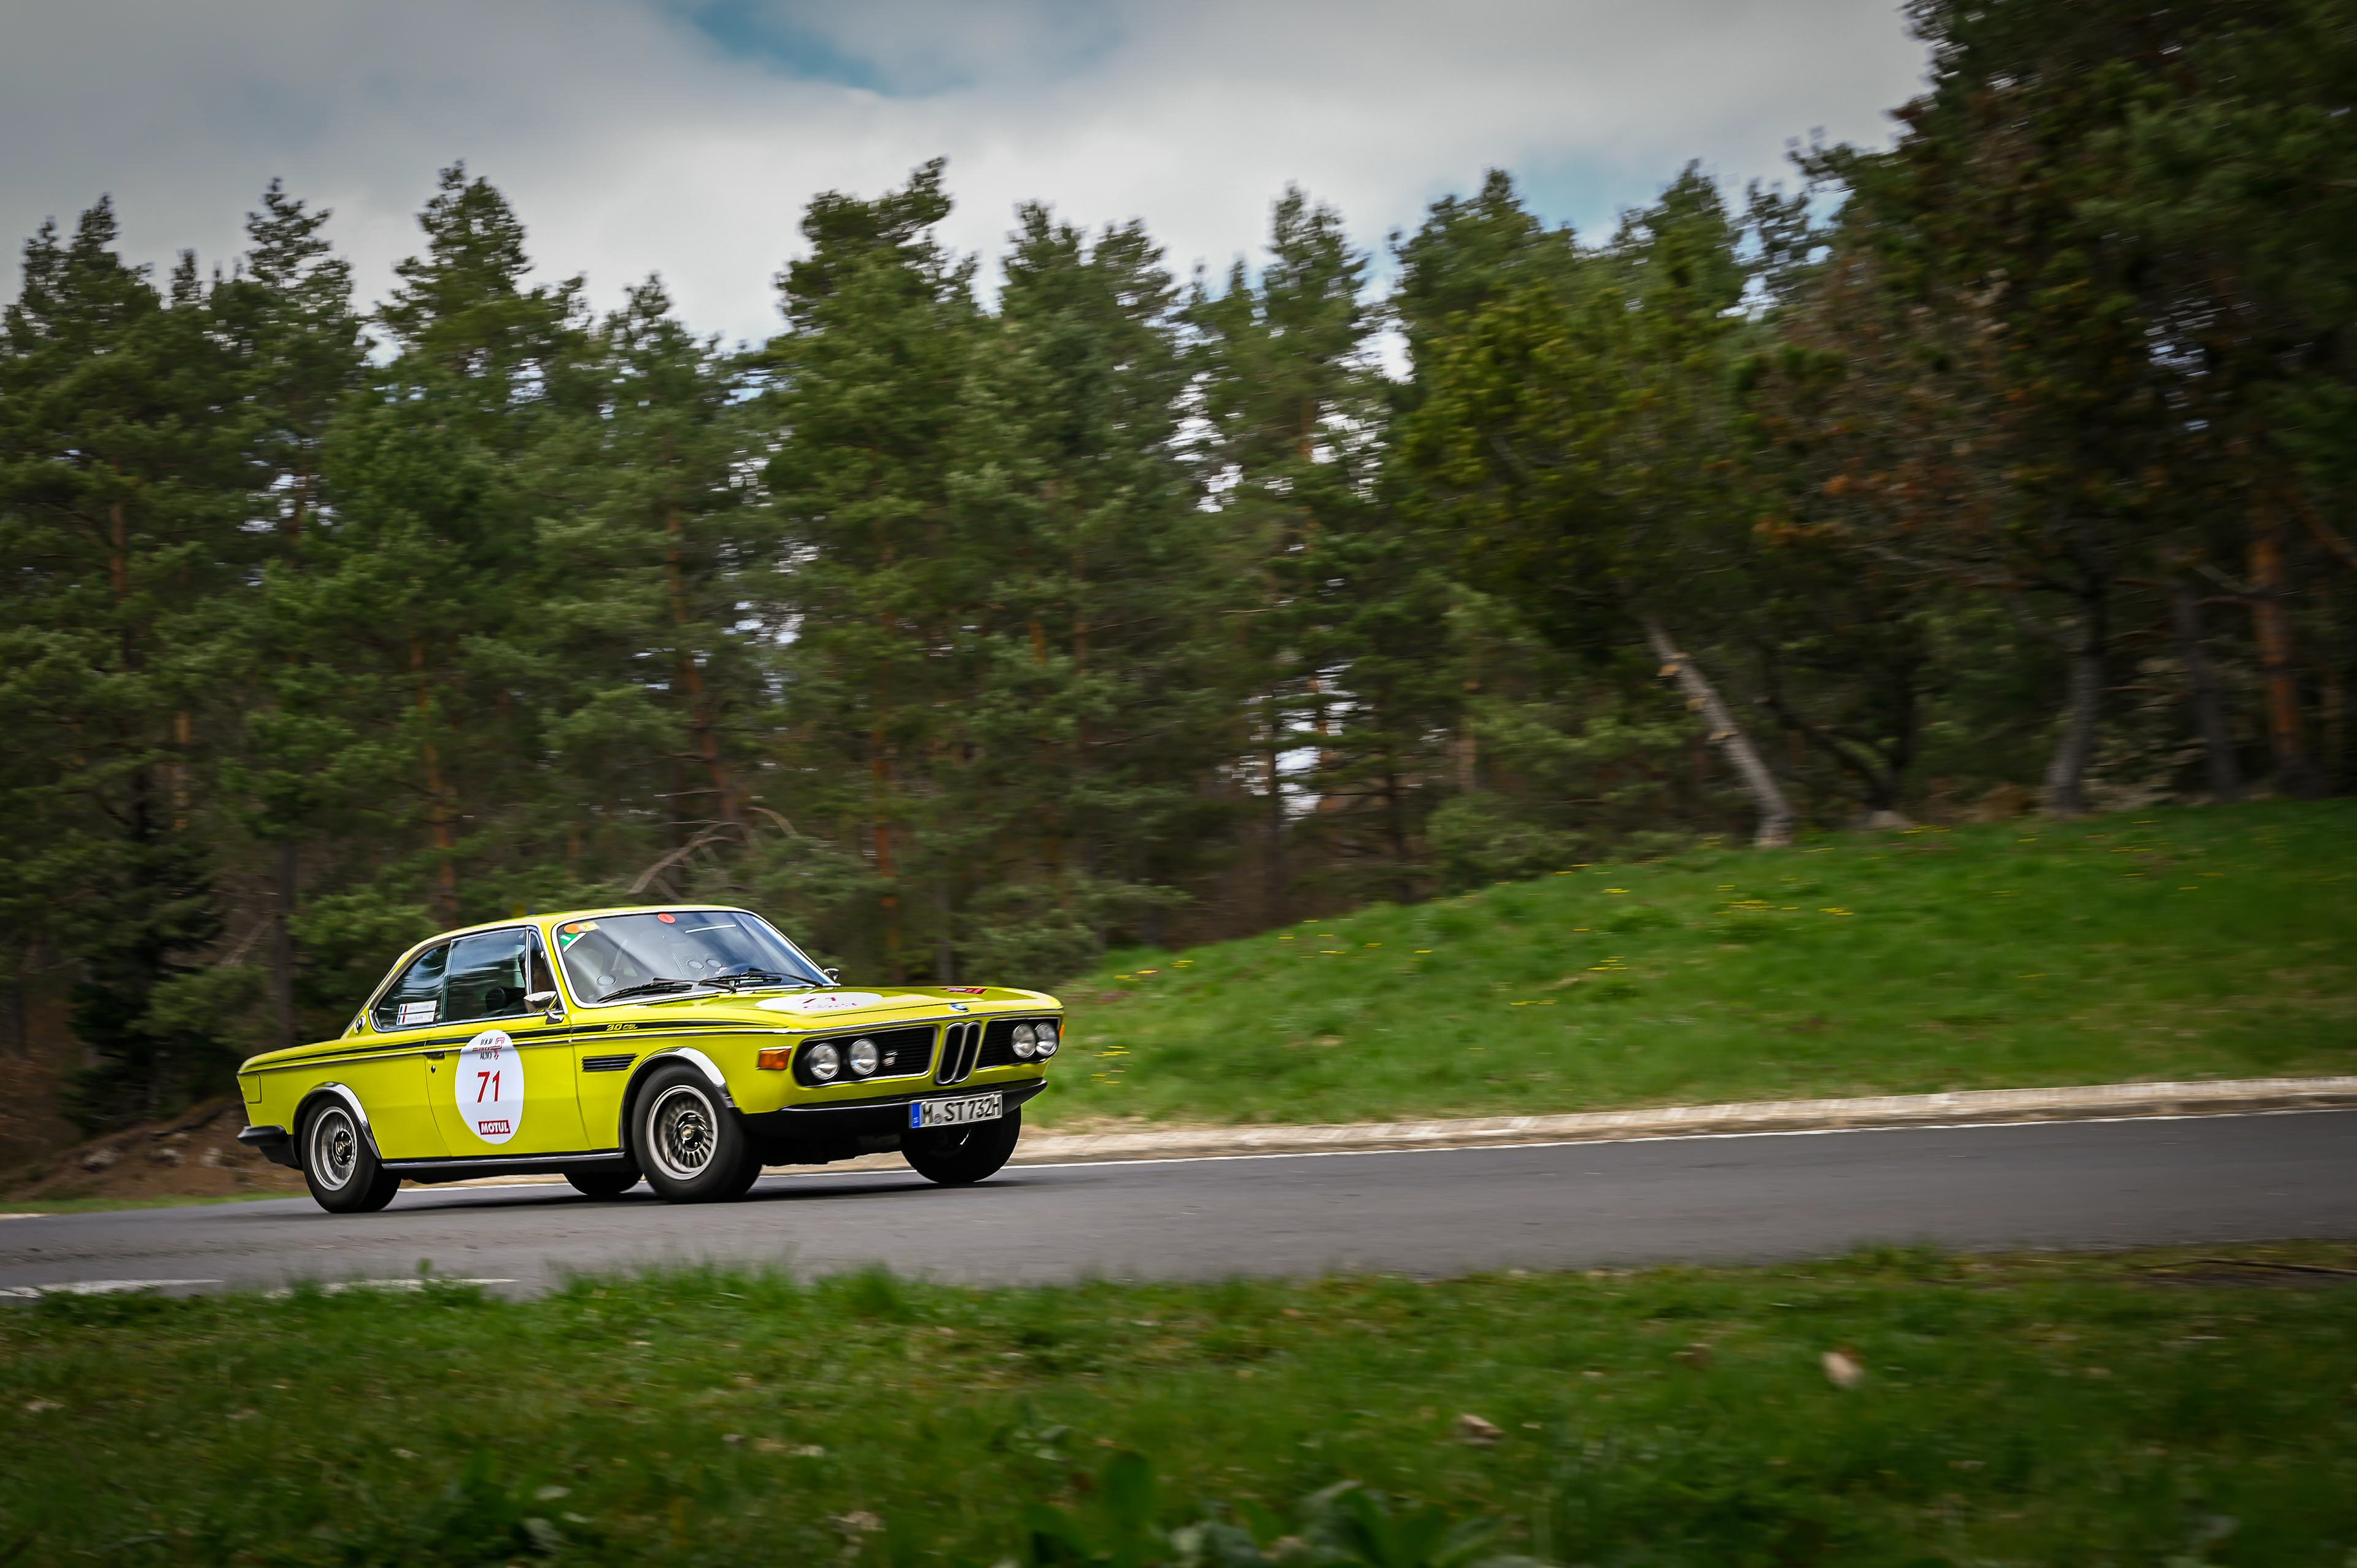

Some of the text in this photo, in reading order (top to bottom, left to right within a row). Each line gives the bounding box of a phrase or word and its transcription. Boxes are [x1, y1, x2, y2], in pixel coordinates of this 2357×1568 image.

[477, 1070, 501, 1103] 71
[967, 1095, 1002, 1120] 732H
[481, 1121, 509, 1134] MOTUL
